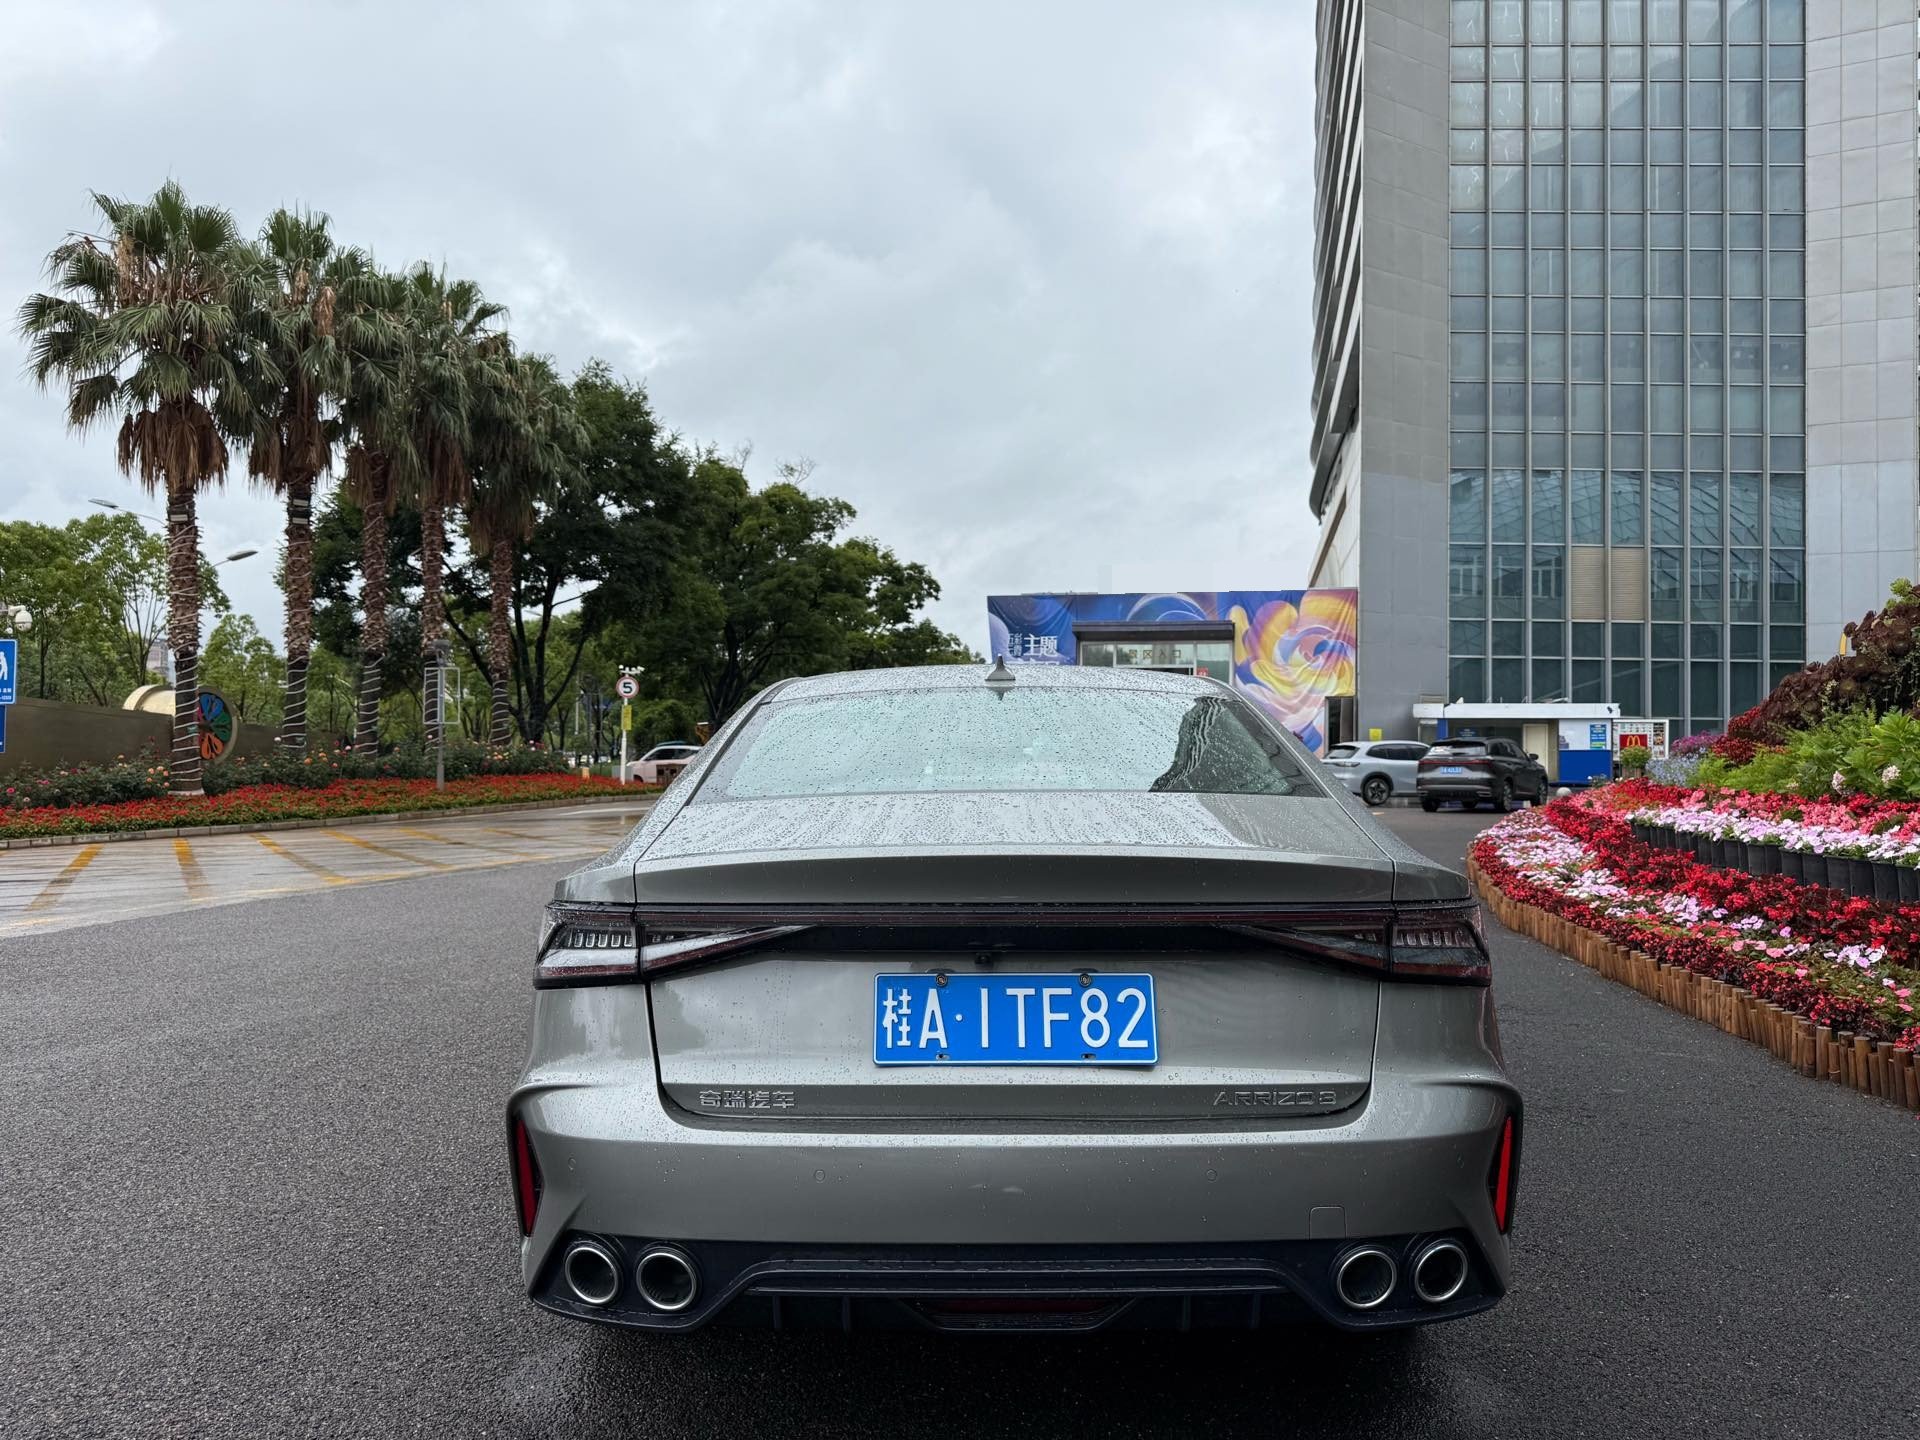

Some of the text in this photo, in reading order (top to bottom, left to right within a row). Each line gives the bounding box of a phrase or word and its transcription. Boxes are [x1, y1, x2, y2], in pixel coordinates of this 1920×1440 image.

[1023, 633, 1058, 657] 主题
[622, 681, 633, 694] 5
[699, 1089, 795, 1109] 奇瑞汽车
[1212, 1091, 1314, 1106] ARRIZO
